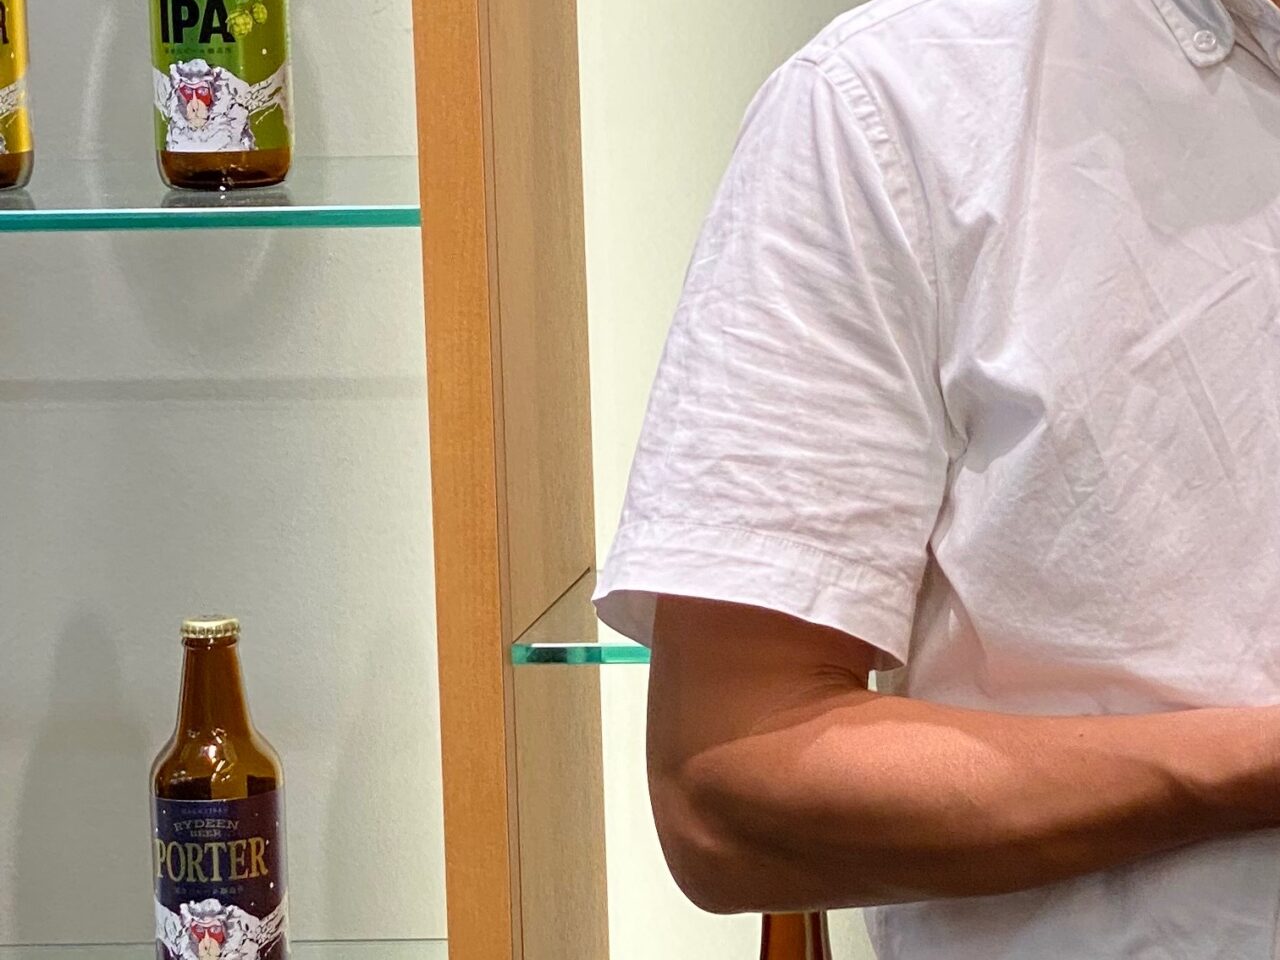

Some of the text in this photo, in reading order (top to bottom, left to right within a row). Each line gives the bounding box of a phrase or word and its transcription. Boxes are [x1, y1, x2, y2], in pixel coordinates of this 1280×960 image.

[172, 818, 240, 832] RYDEEN
[190, 829, 222, 838] BEER
[156, 837, 269, 883] PORTER
